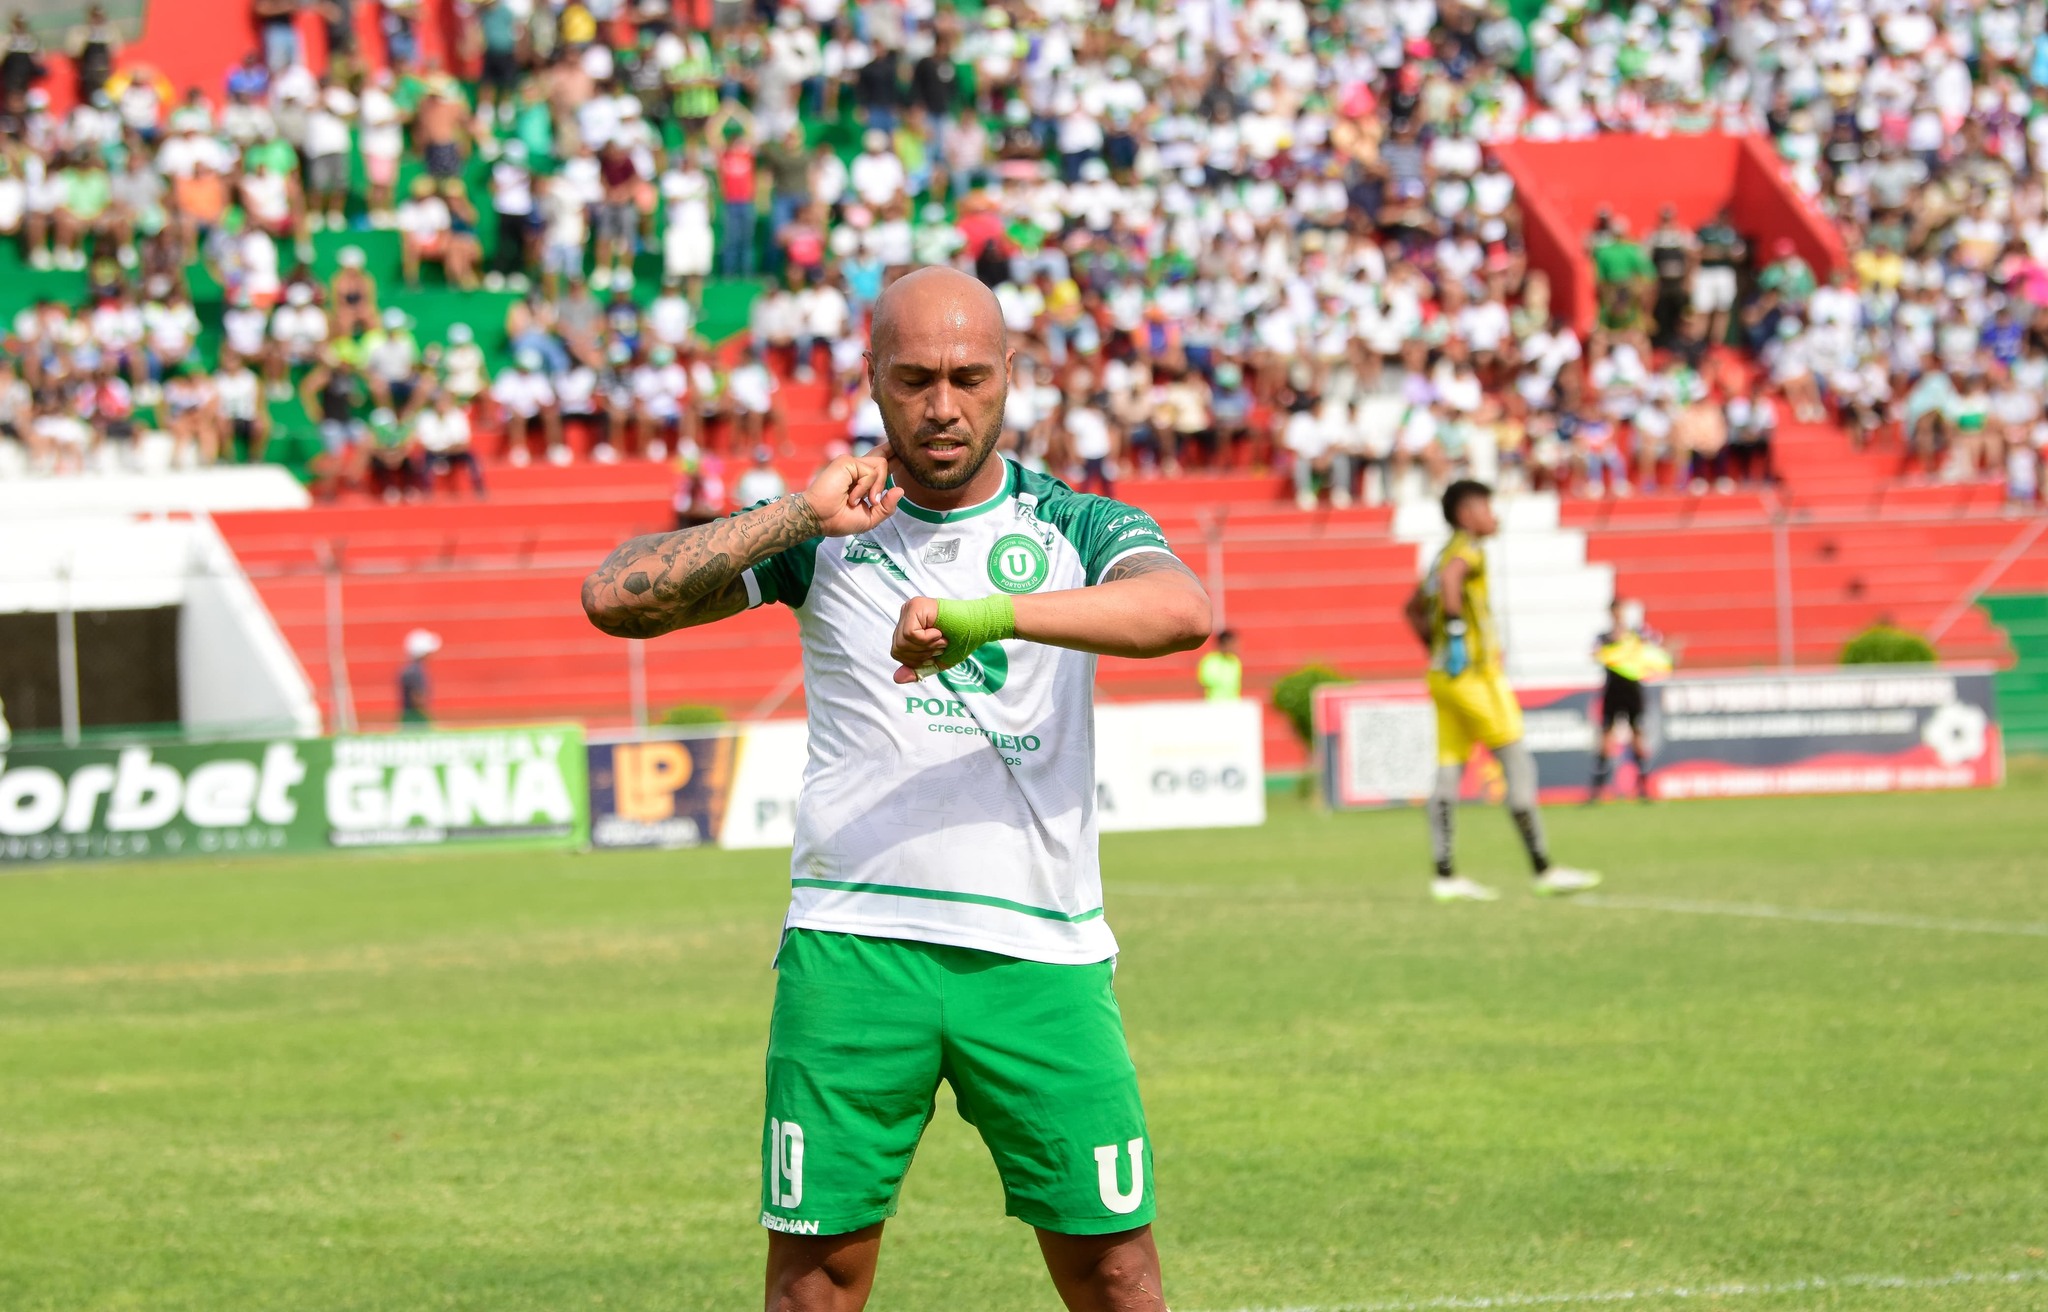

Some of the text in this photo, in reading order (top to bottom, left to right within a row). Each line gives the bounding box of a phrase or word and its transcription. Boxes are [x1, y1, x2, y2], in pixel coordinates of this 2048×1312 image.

[1001, 577, 1038, 589] PORTOVIEJO
[1008, 554, 1027, 576] U
[0, 741, 306, 836] orbet
[325, 760, 574, 829] GANA
[770, 1116, 805, 1209] 19
[1094, 1136, 1144, 1214] U
